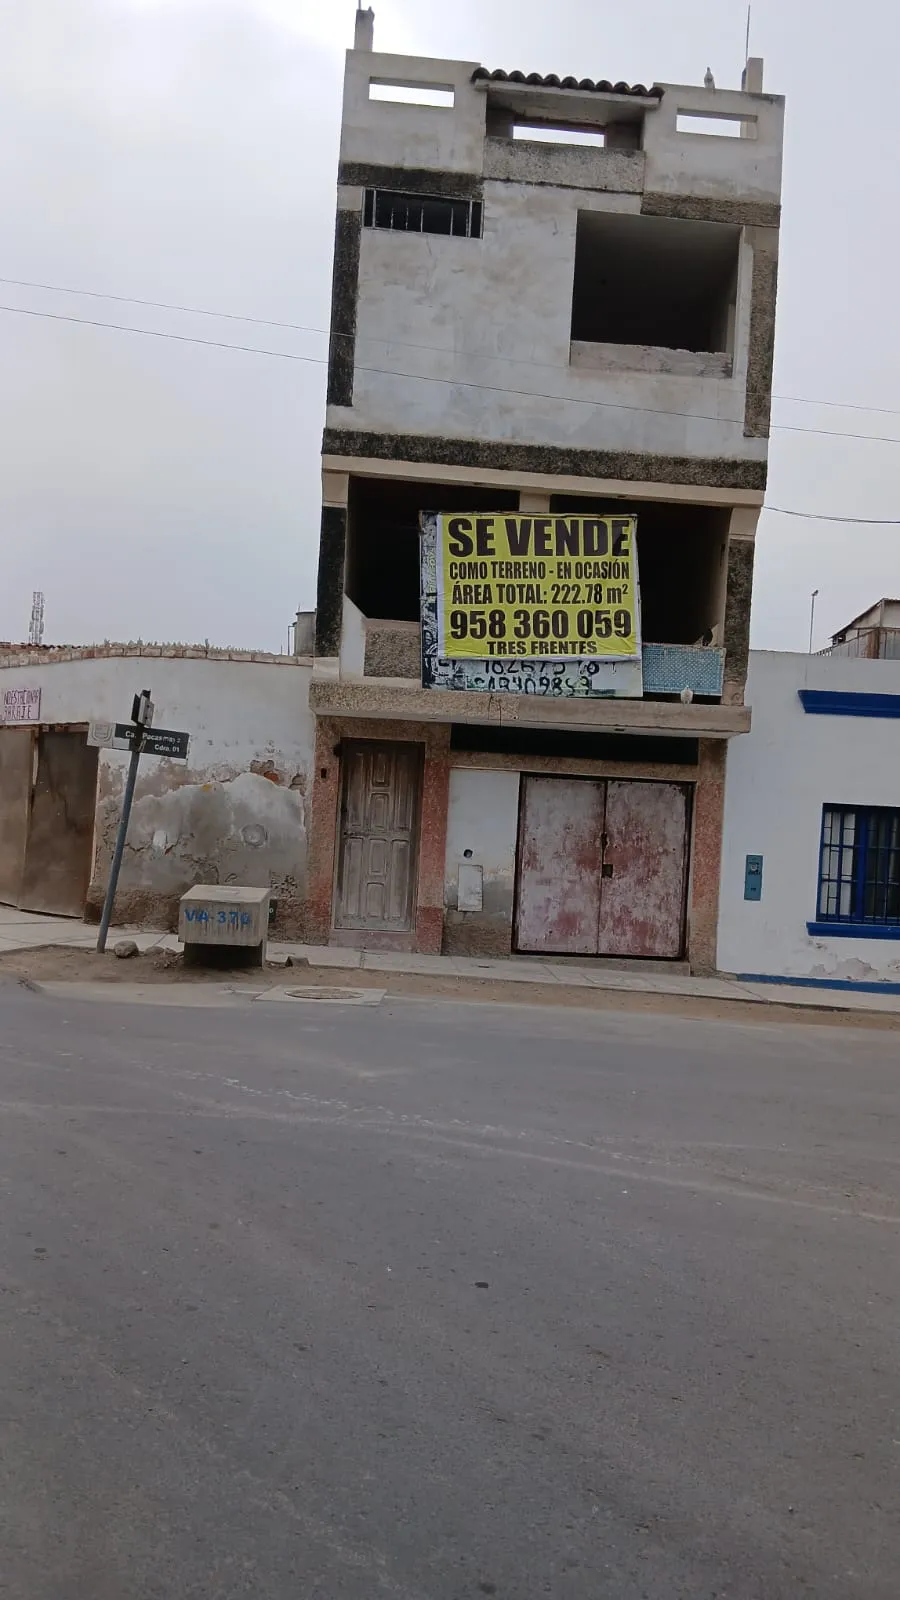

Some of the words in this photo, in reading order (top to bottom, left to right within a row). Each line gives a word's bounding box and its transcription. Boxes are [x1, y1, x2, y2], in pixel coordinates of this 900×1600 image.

[448, 518, 496, 557] SE
[504, 518, 630, 557] VENDE
[449, 561, 488, 580] COMO
[491, 561, 546, 580] TERRENO
[556, 561, 572, 580] EN
[575, 559, 630, 580] OCASIÓN
[451, 581, 492, 605] ÁREA
[496, 583, 548, 605] TOTAL:
[551, 583, 603, 605] 222.78
[450, 609, 506, 640] 958
[513, 609, 569, 639] 360
[577, 609, 632, 639] 059
[487, 641, 527, 655] TRES
[531, 641, 598, 655] FRENTES
[125, 730, 137, 739] Ca.
[154, 744, 171, 752] Cdra.
[172, 745, 180, 753] 01
